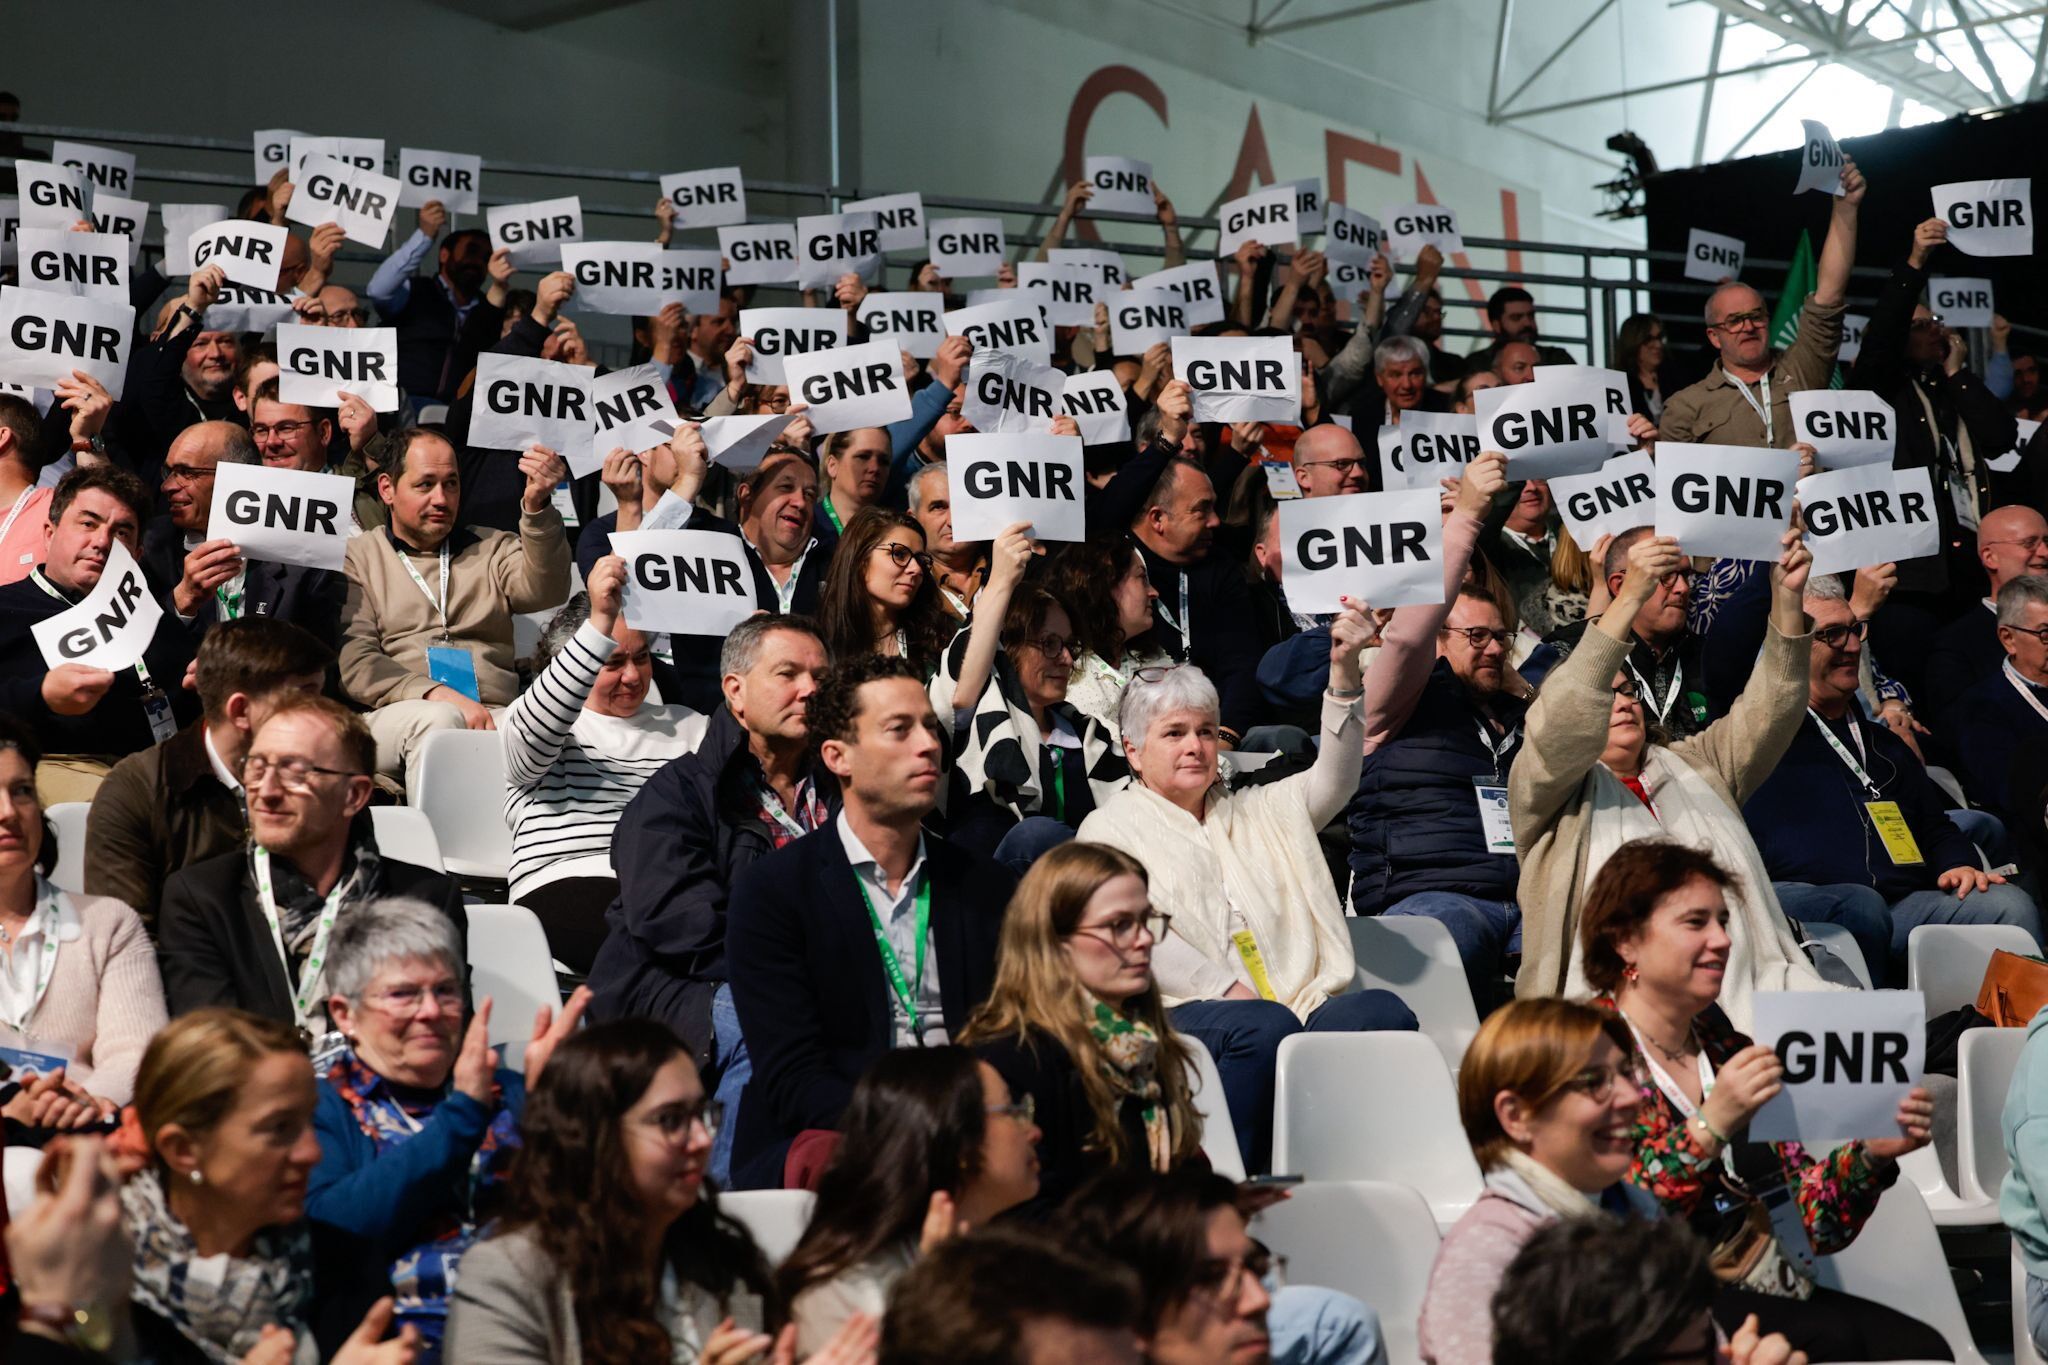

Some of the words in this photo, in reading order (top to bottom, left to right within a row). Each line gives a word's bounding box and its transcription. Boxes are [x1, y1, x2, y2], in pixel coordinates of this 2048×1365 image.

[408, 165, 472, 192] GNR
[1094, 170, 1149, 194] GNR
[29, 180, 84, 211] GN
[306, 174, 387, 220] GNR
[672, 183, 738, 206] GNR
[92, 212, 136, 242] NR
[500, 215, 575, 244] GNR
[877, 208, 918, 230] NR
[1228, 204, 1289, 234] GNR
[1394, 215, 1455, 236] GNR
[1947, 199, 2026, 229] GNR
[809, 229, 880, 261] GNR
[937, 233, 1001, 254] GNR
[1333, 219, 1379, 250] GNR
[194, 236, 273, 267] GNR
[730, 240, 795, 261] GNR
[1694, 243, 1740, 270] GNR
[31, 250, 120, 286] GNR
[575, 260, 654, 288] GNR
[1336, 265, 1372, 283] GN
[1028, 279, 1094, 304] NR
[1937, 290, 1990, 309] GNR
[864, 309, 938, 334] GNR
[962, 317, 1040, 349] GNR
[1119, 305, 1186, 331] GNR
[11, 315, 121, 364] GNR
[753, 327, 838, 355] GNR
[289, 348, 387, 381] GNR
[1186, 360, 1286, 391] GNR
[802, 362, 897, 405] GNR
[978, 372, 1053, 418] GNR
[487, 380, 587, 421] GNR
[595, 384, 663, 432] NR
[1061, 387, 1121, 416] NR
[1492, 404, 1599, 449] GNR
[1805, 410, 1888, 440] GNR
[1411, 433, 1480, 463] GNR
[963, 461, 1076, 501] GNR
[1671, 473, 1785, 520] GNR
[225, 489, 338, 535] GNR
[1568, 473, 1656, 522] GNR
[1803, 490, 1896, 536] GNR
[1297, 521, 1432, 571] GNR
[634, 553, 747, 597] GNR
[58, 570, 143, 659] GNR
[1775, 1031, 1910, 1085] GNR
